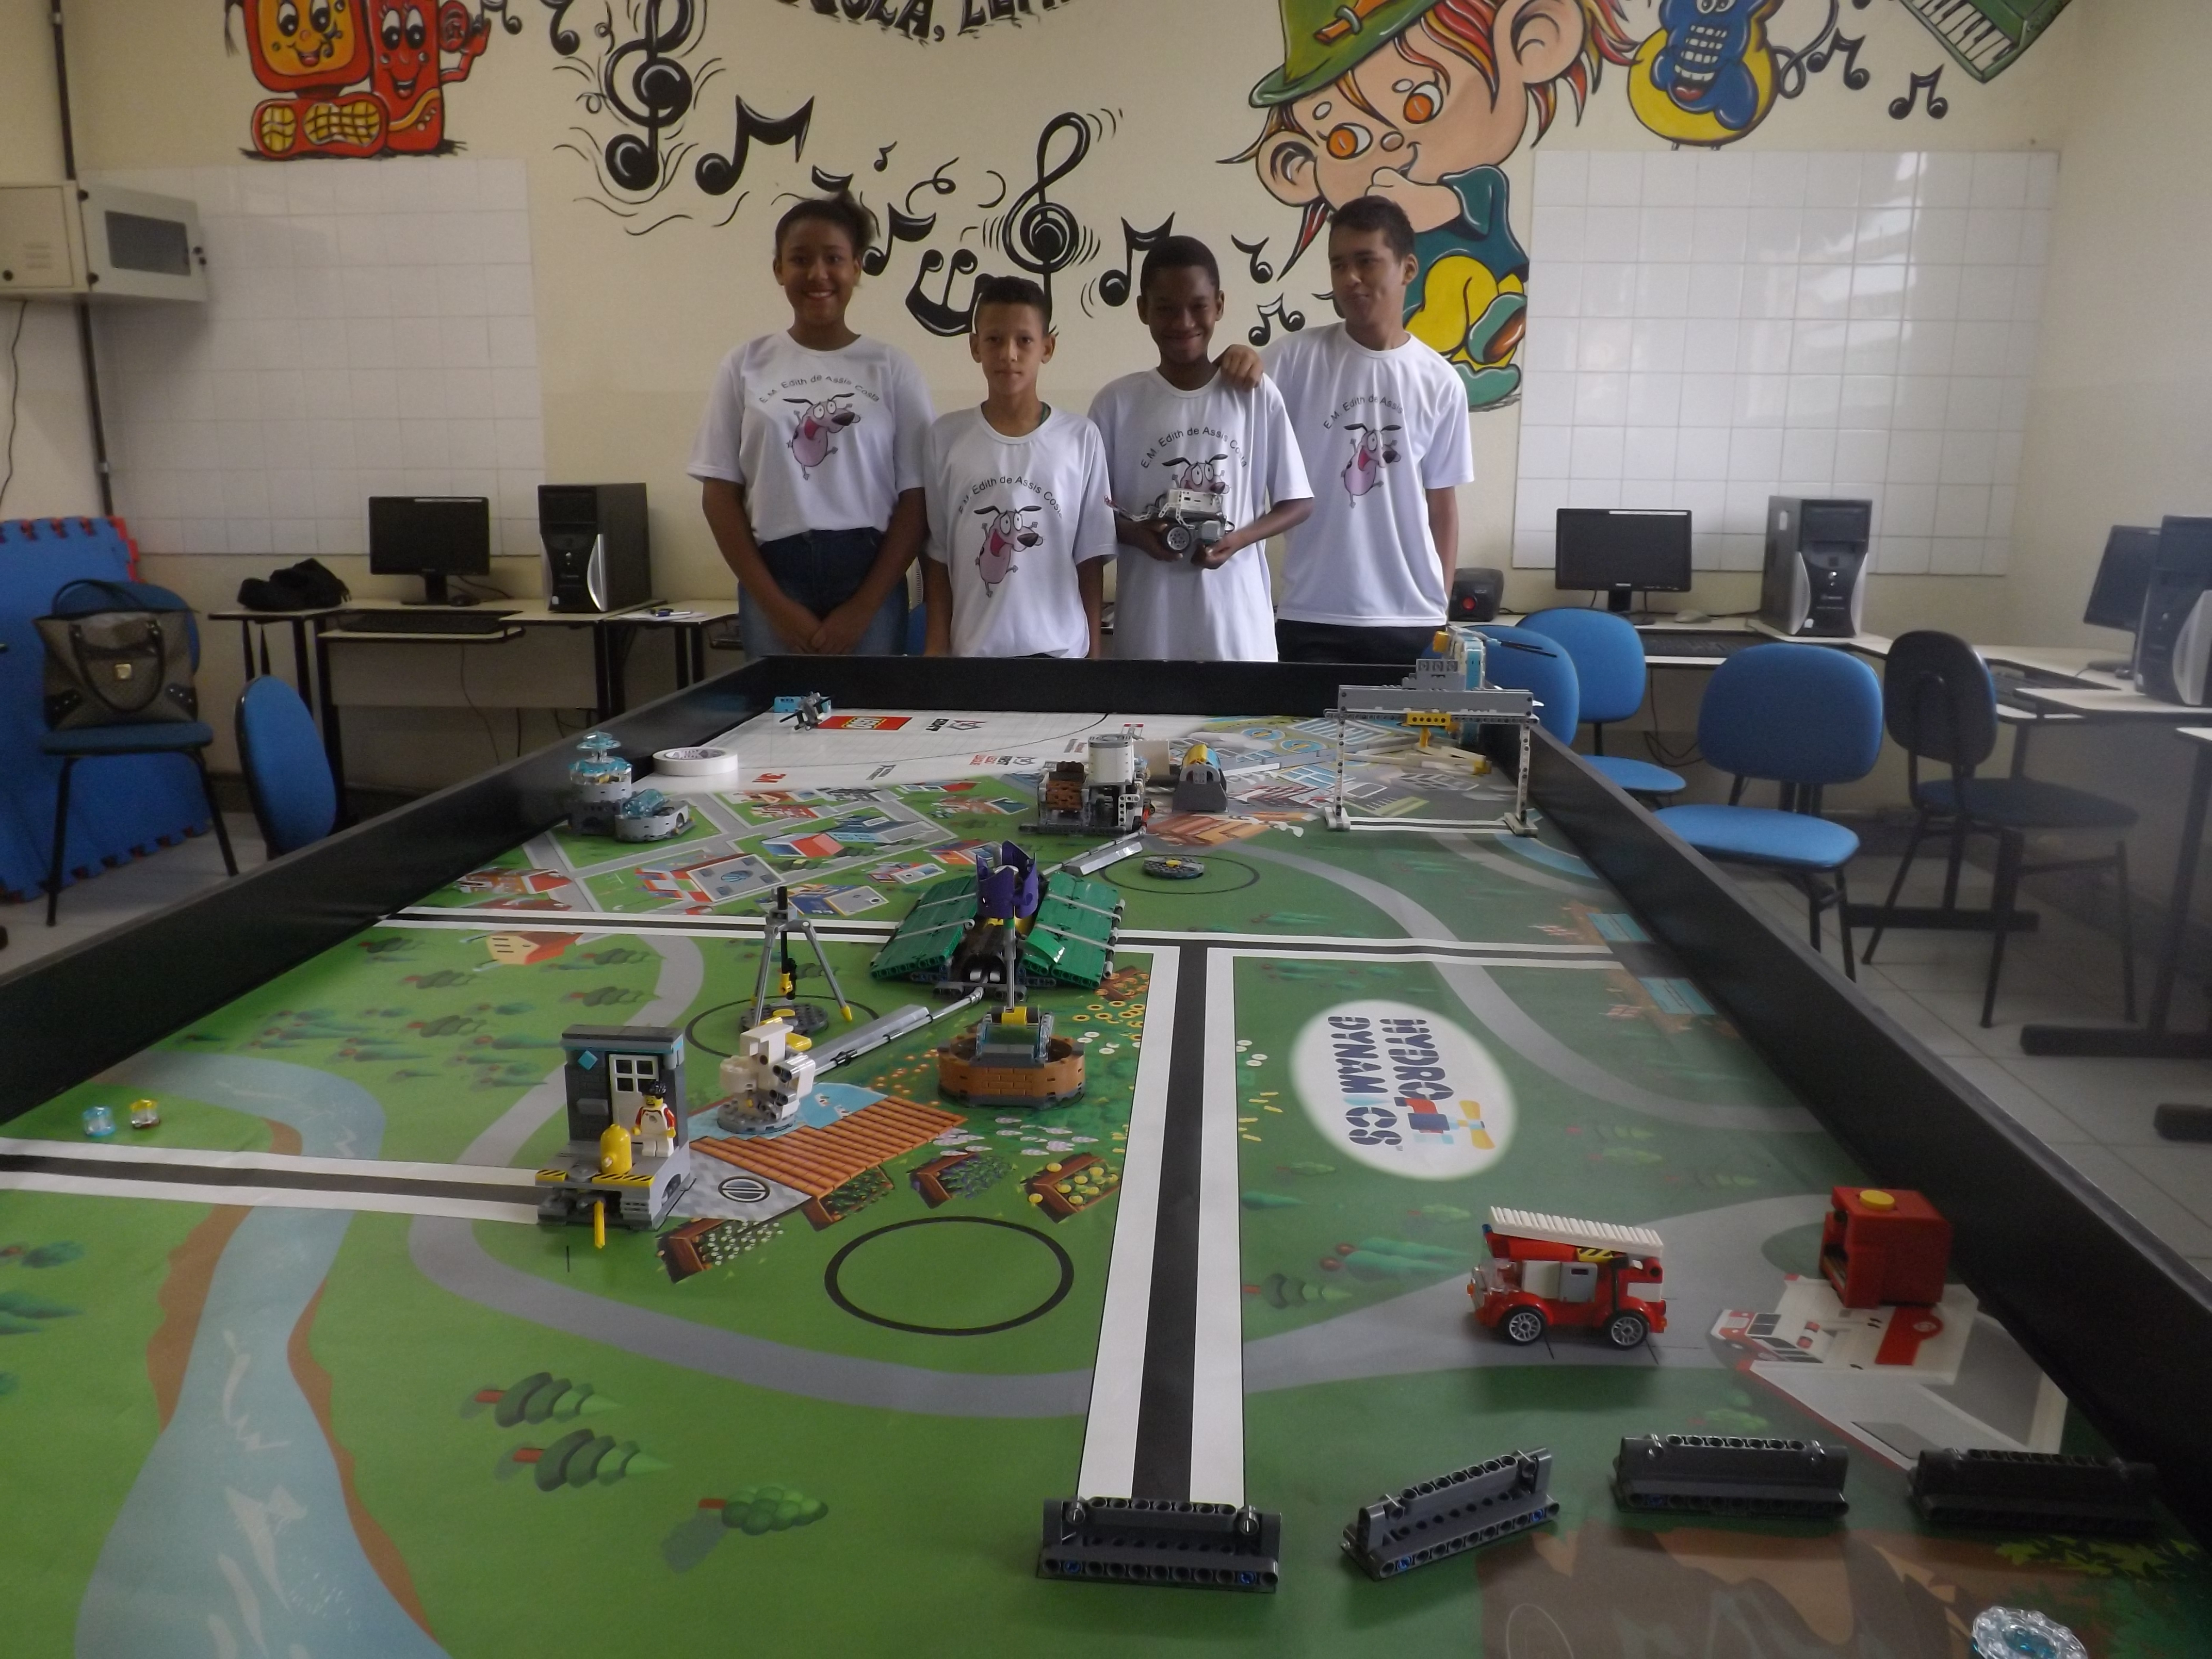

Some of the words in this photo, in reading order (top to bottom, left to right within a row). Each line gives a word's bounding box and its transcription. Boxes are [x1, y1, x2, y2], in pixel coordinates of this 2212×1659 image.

[780, 378, 807, 388] Edith
[810, 375, 822, 383] de
[825, 376, 852, 385] Assis
[855, 385, 880, 402] Costa
[1342, 396, 1365, 412] Edith
[1380, 396, 1404, 414] Assis
[1158, 430, 1184, 448] Edith
[1187, 427, 1199, 436] de
[1202, 426, 1229, 442] Assis
[972, 478, 997, 495] Edith
[1000, 476, 1013, 484] de
[1015, 476, 1042, 494] Assis
[1379, 1019, 1455, 1100] HYDRO
